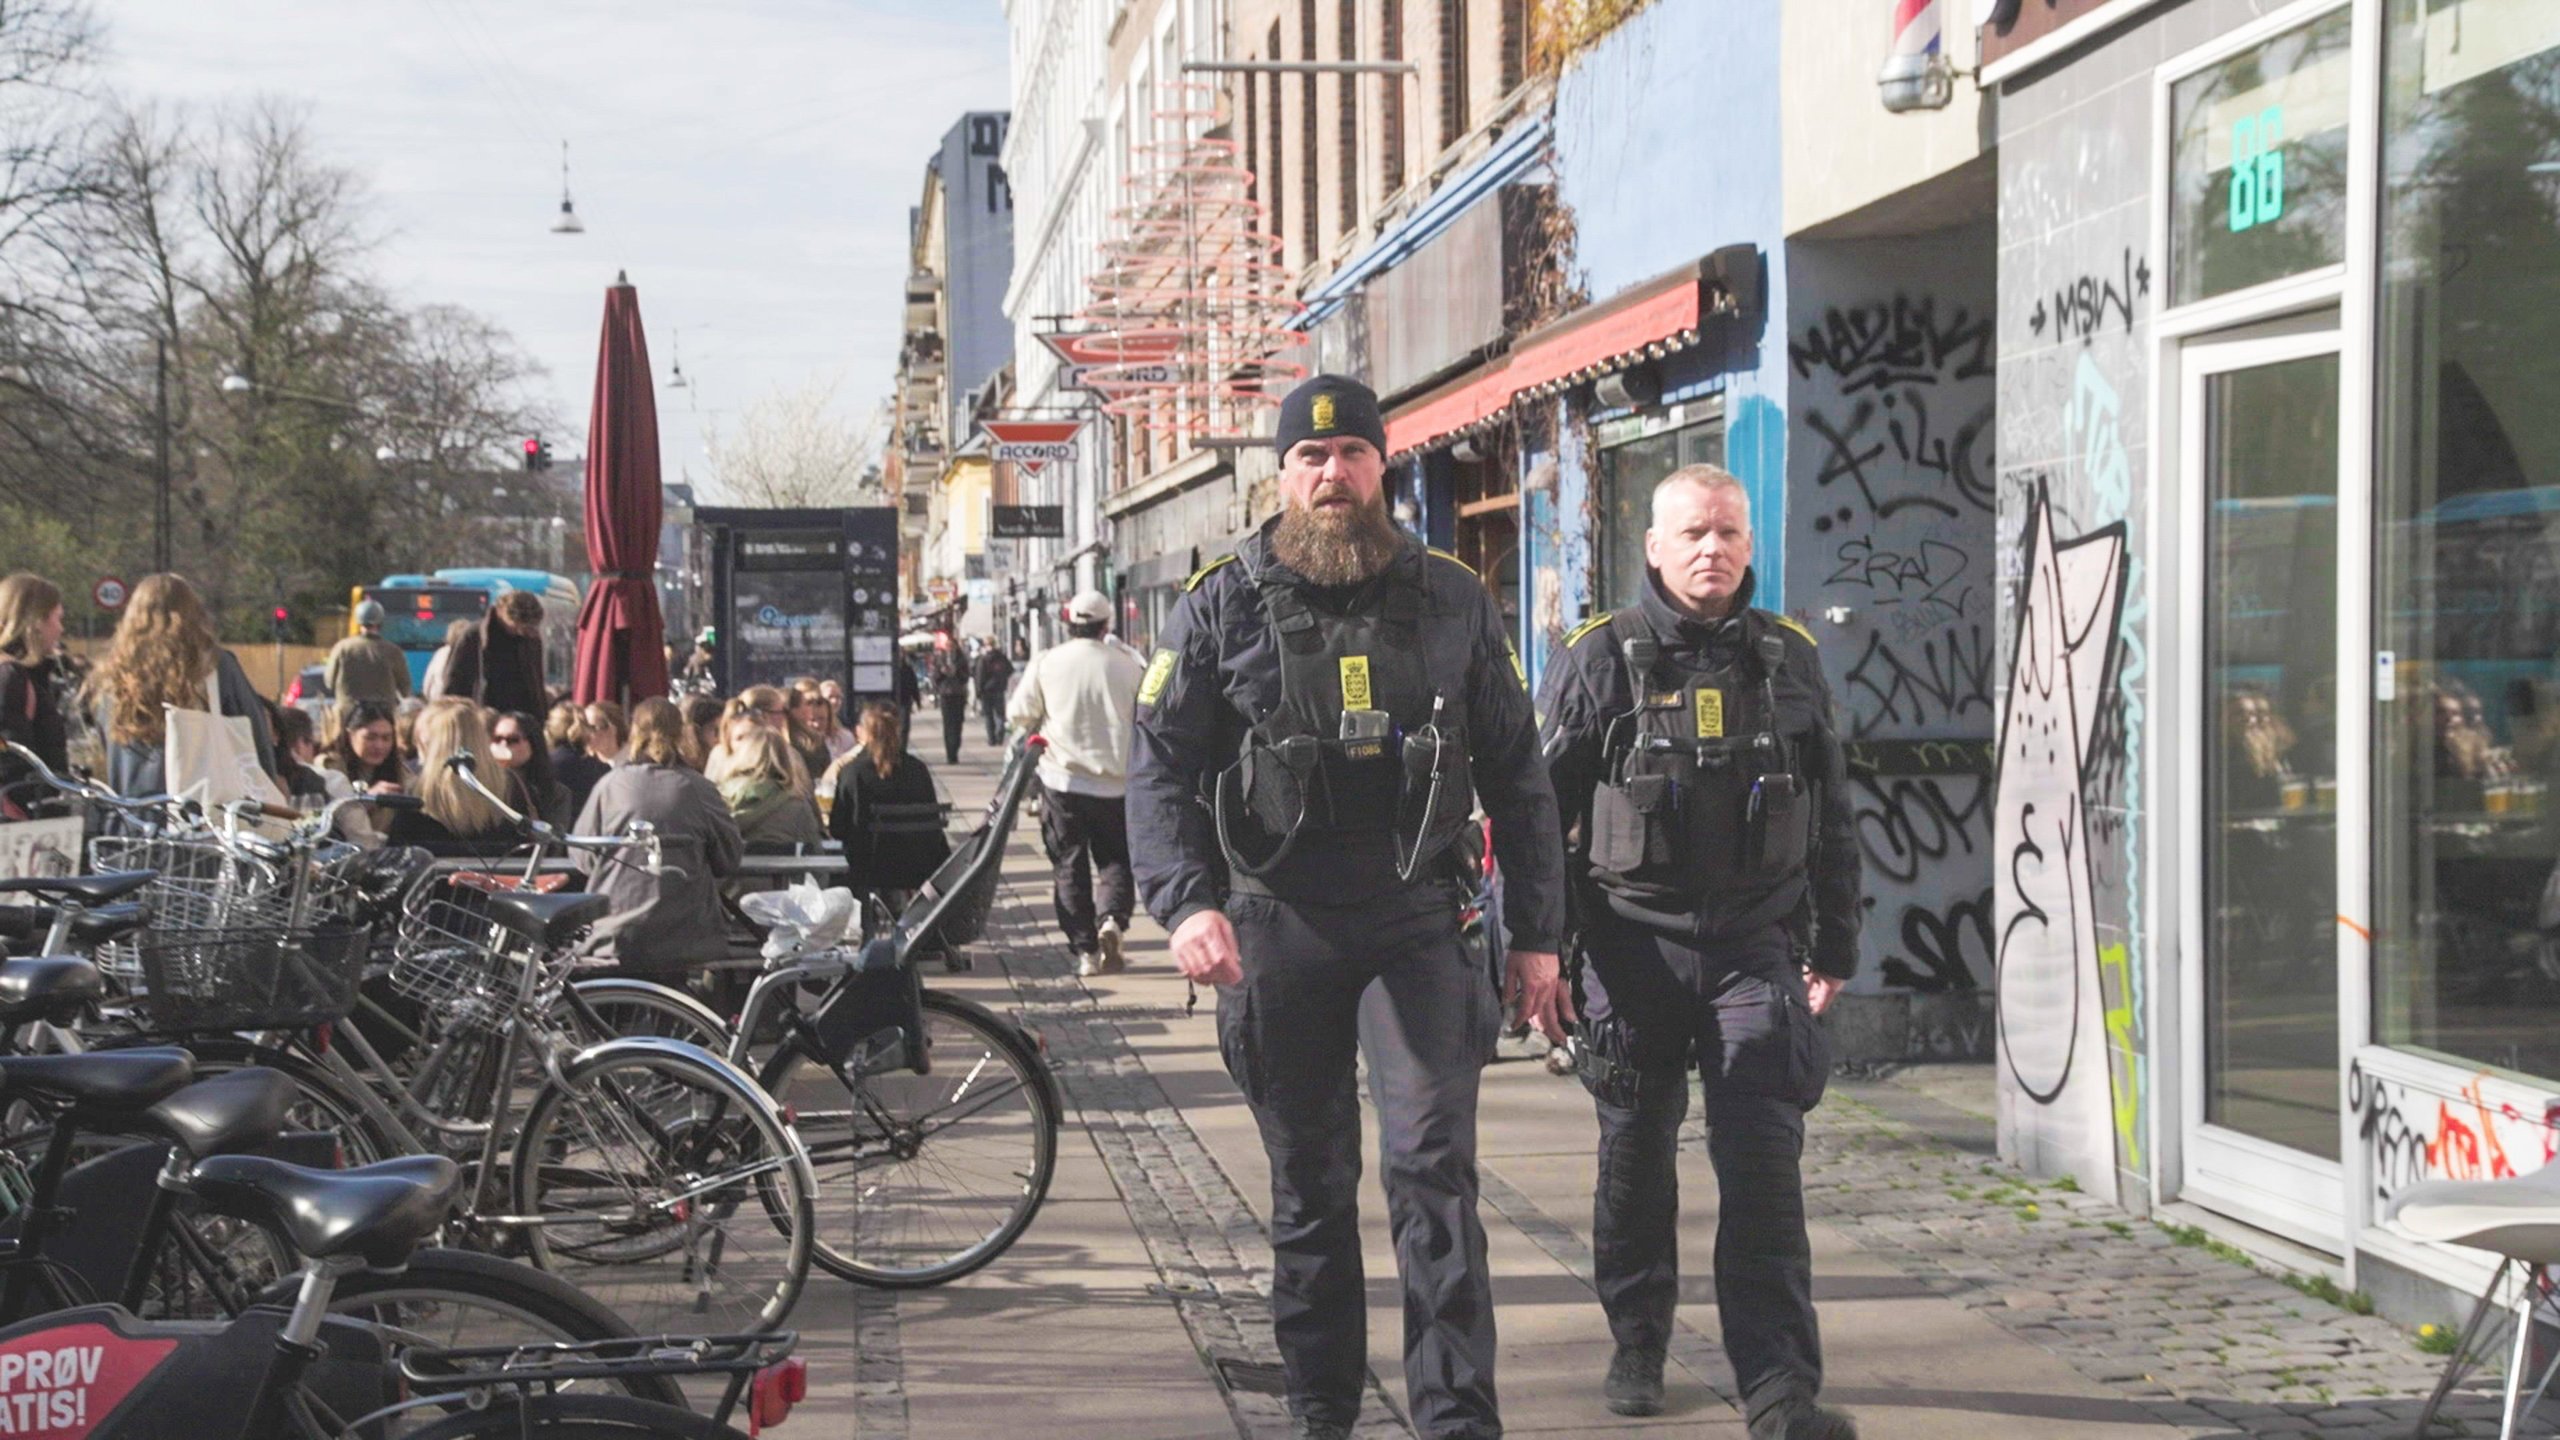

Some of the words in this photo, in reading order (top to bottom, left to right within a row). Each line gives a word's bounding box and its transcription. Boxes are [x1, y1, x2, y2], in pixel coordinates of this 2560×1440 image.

[2230, 104, 2284, 232] 86
[999, 445, 1070, 459] ACCORD
[100, 585, 121, 601] 40
[0, 1346, 104, 1393] PRØV
